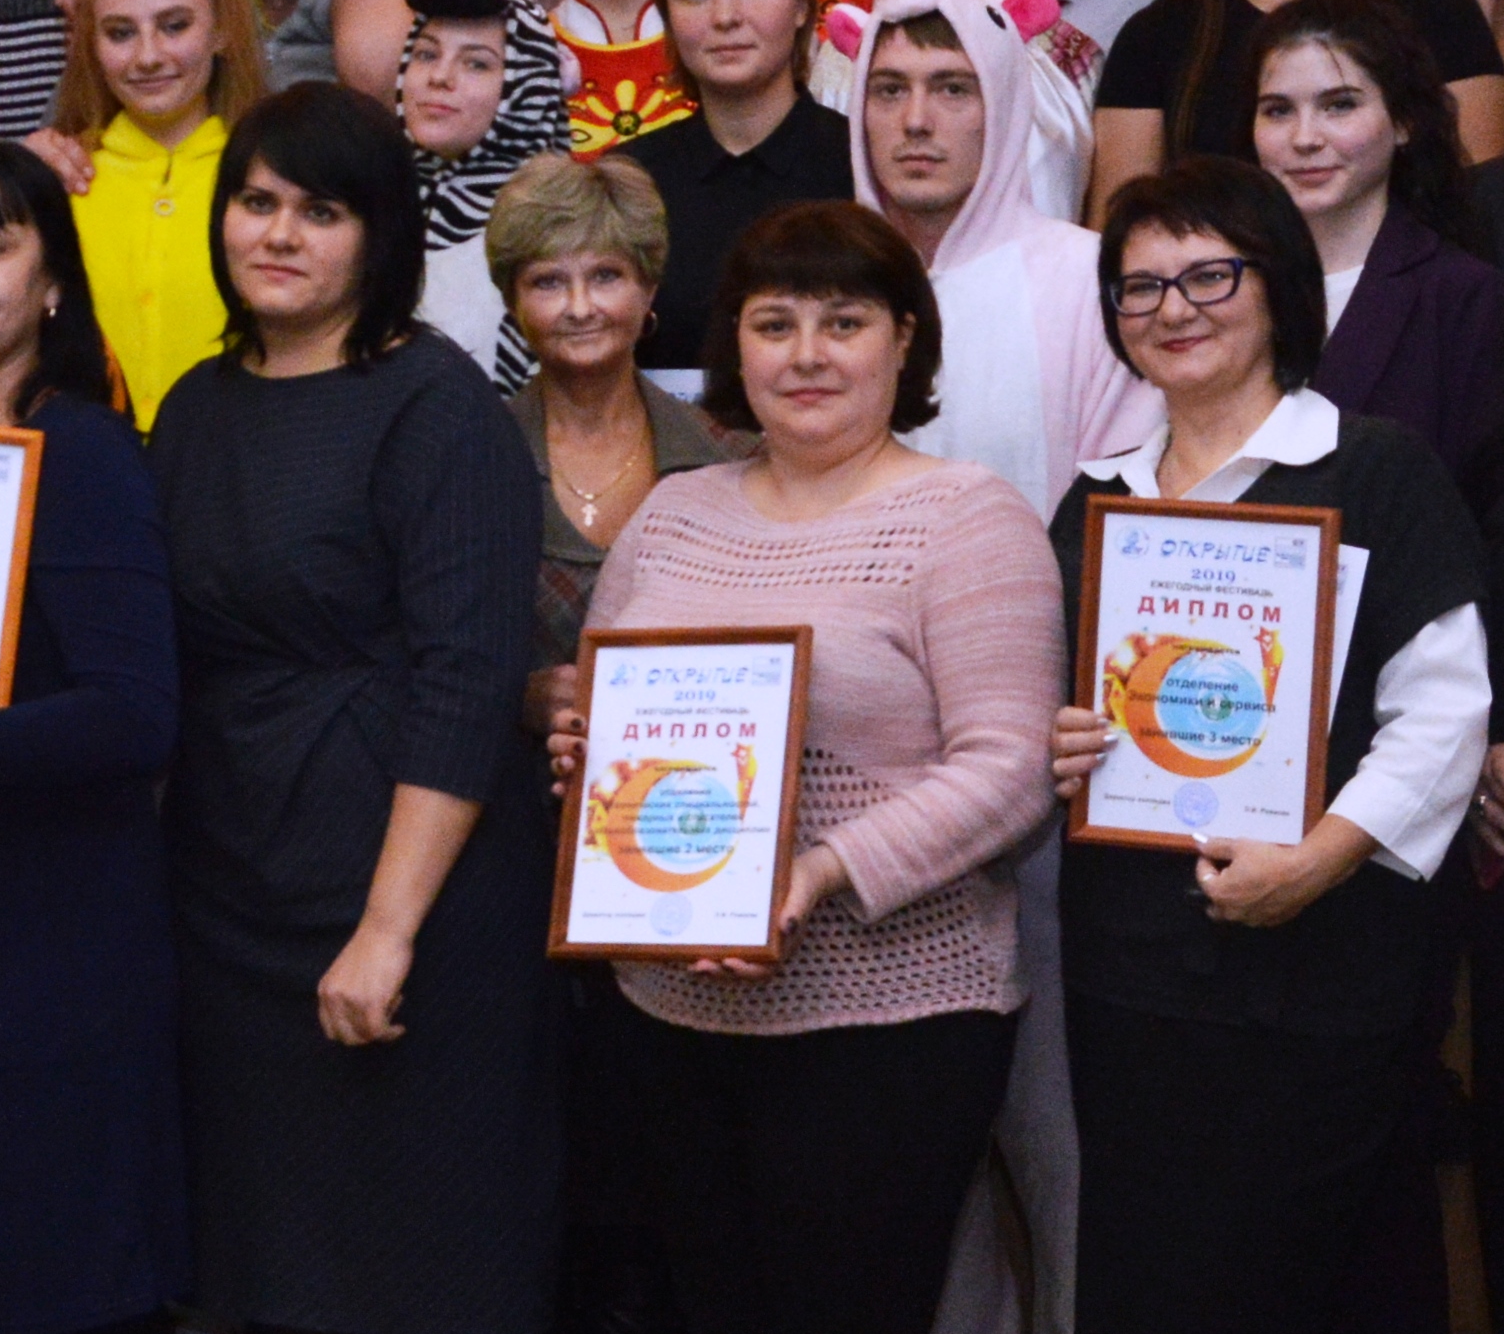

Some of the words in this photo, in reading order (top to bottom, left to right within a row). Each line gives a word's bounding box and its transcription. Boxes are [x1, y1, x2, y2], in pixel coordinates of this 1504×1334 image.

[1160, 539, 1271, 562] ОТКРЫТИЕ
[1191, 568, 1235, 582] 2019
[1137, 595, 1280, 623] ДИПЛОМ
[673, 689, 716, 701] 2019
[622, 722, 756, 739] ДИПЛОМ
[1209, 731, 1216, 741] 3
[1221, 734, 1261, 746] место
[685, 843, 692, 853] 2
